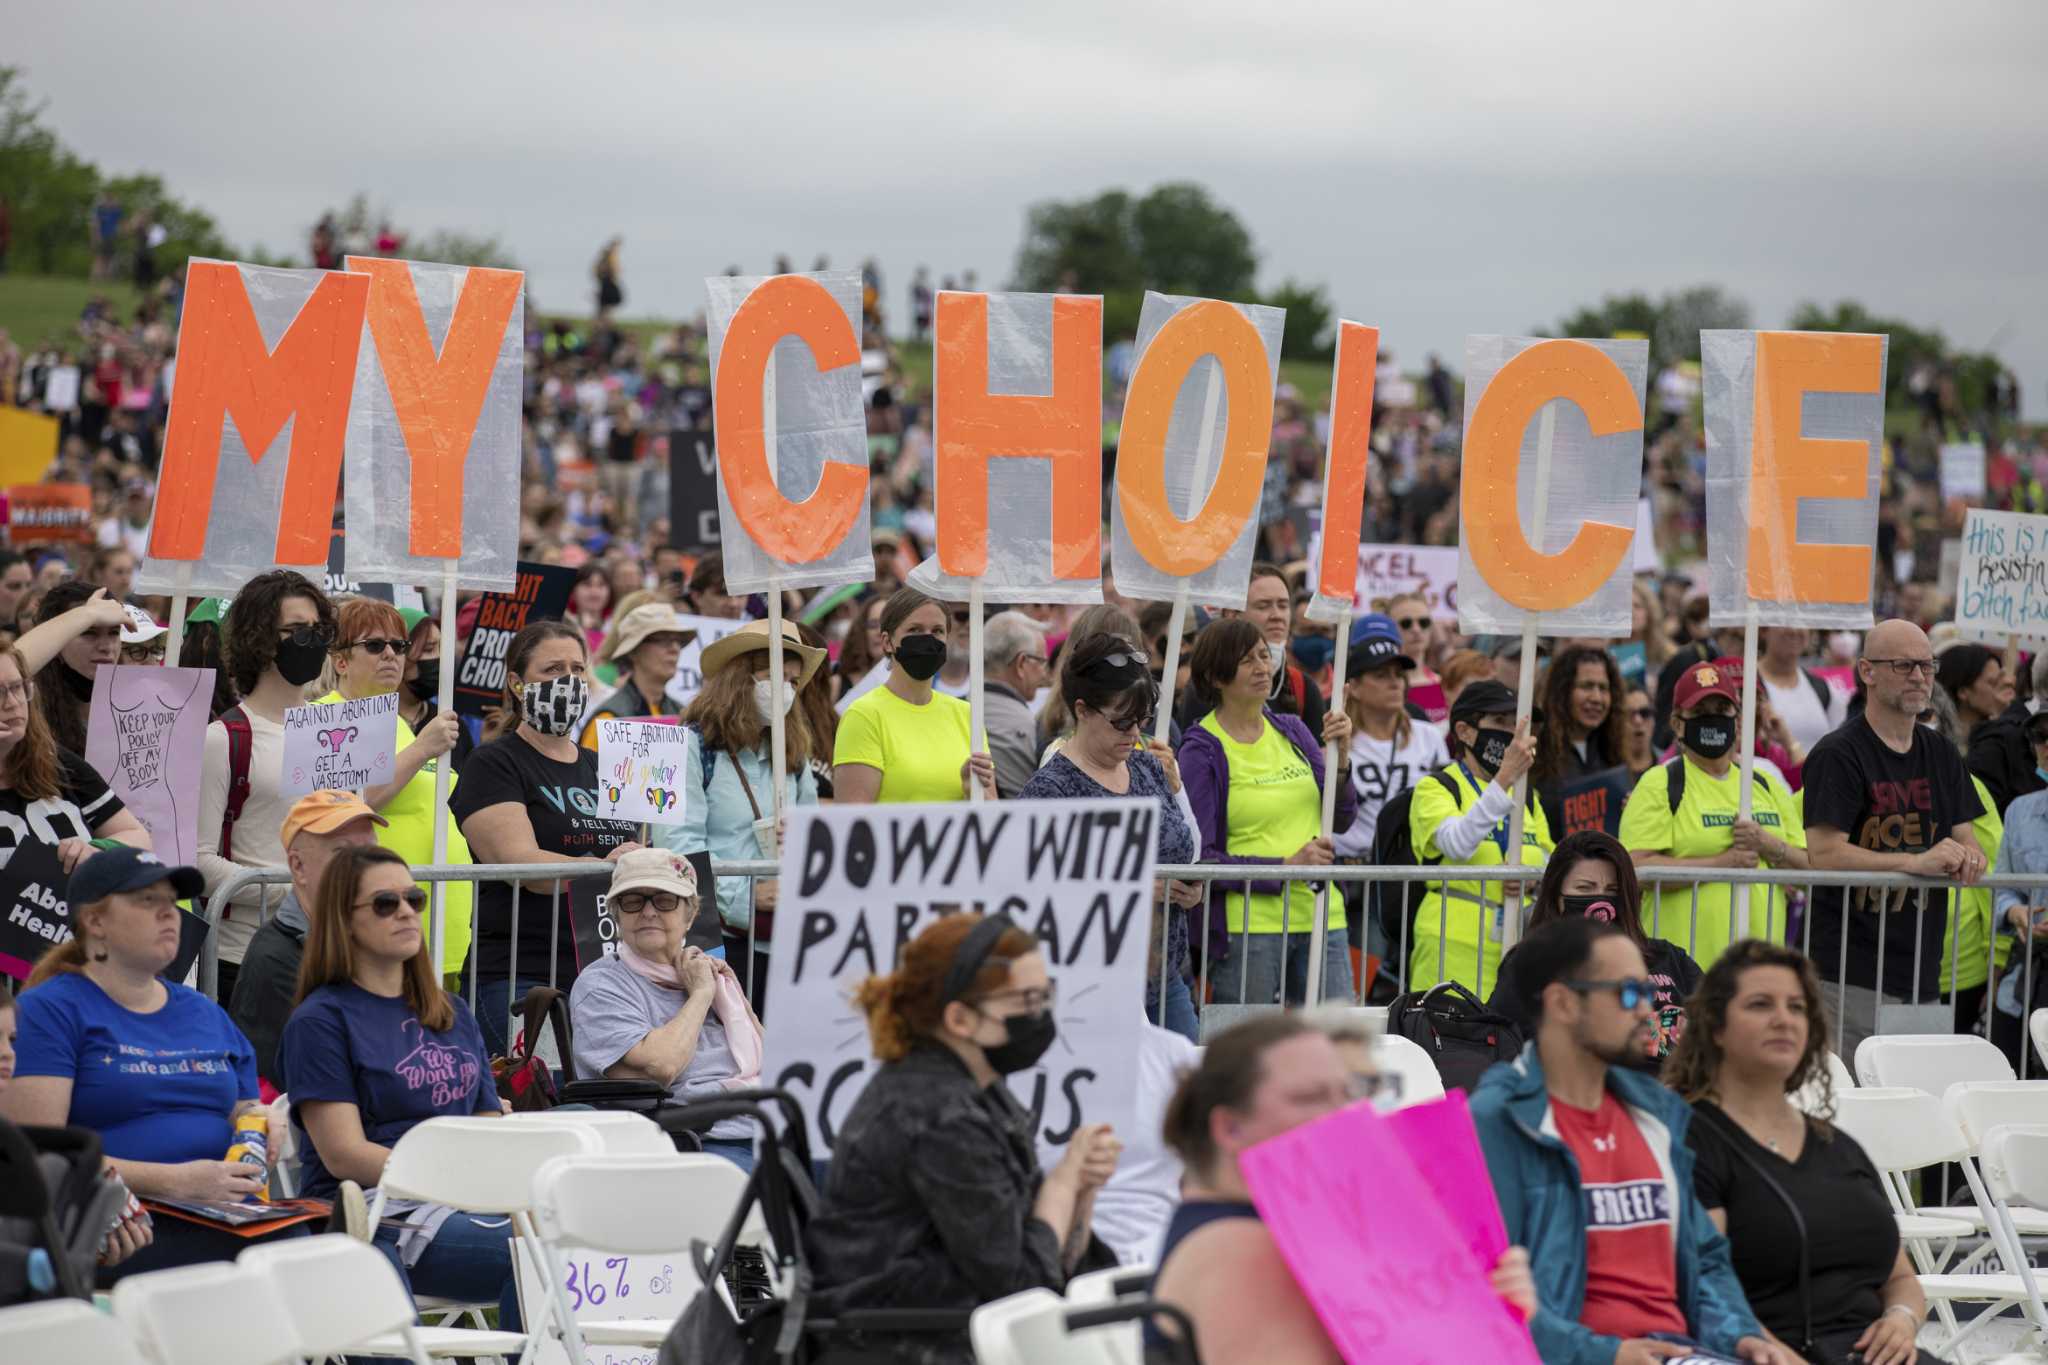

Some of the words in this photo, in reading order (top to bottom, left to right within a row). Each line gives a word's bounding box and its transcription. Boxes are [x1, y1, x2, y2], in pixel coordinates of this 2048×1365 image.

[148, 256, 525, 566] MY
[1967, 517, 2005, 556] this
[2015, 521, 2035, 553] is
[1963, 576, 2017, 629] bitch
[478, 599, 531, 631] BACK
[468, 627, 517, 659] PRO
[284, 703, 336, 730] AGAINST
[339, 692, 398, 722] ABORTION?
[118, 712, 149, 735] KEEP
[152, 712, 176, 729] YOUR
[603, 721, 632, 744] SAFE
[639, 724, 685, 745] ABORTIONS
[127, 729, 162, 749] POLICY
[632, 742, 650, 758] FOR
[120, 751, 139, 769] OFF
[145, 747, 161, 763] MY
[315, 754, 338, 773] GET
[341, 752, 352, 768] A
[127, 762, 159, 786] BODY
[311, 768, 372, 792] VASECTOMY
[582, 819, 607, 830] TELL
[598, 834, 625, 846] SENT
[799, 811, 1011, 898] DOWN
[1027, 807, 1155, 882] WITH
[793, 891, 1142, 985] PARAN
[120, 1060, 158, 1075] safe
[159, 1059, 190, 1075] and
[191, 1059, 229, 1076] legal
[420, 1047, 456, 1069] We
[565, 1256, 631, 1313] 36%
[649, 1265, 673, 1295] of
